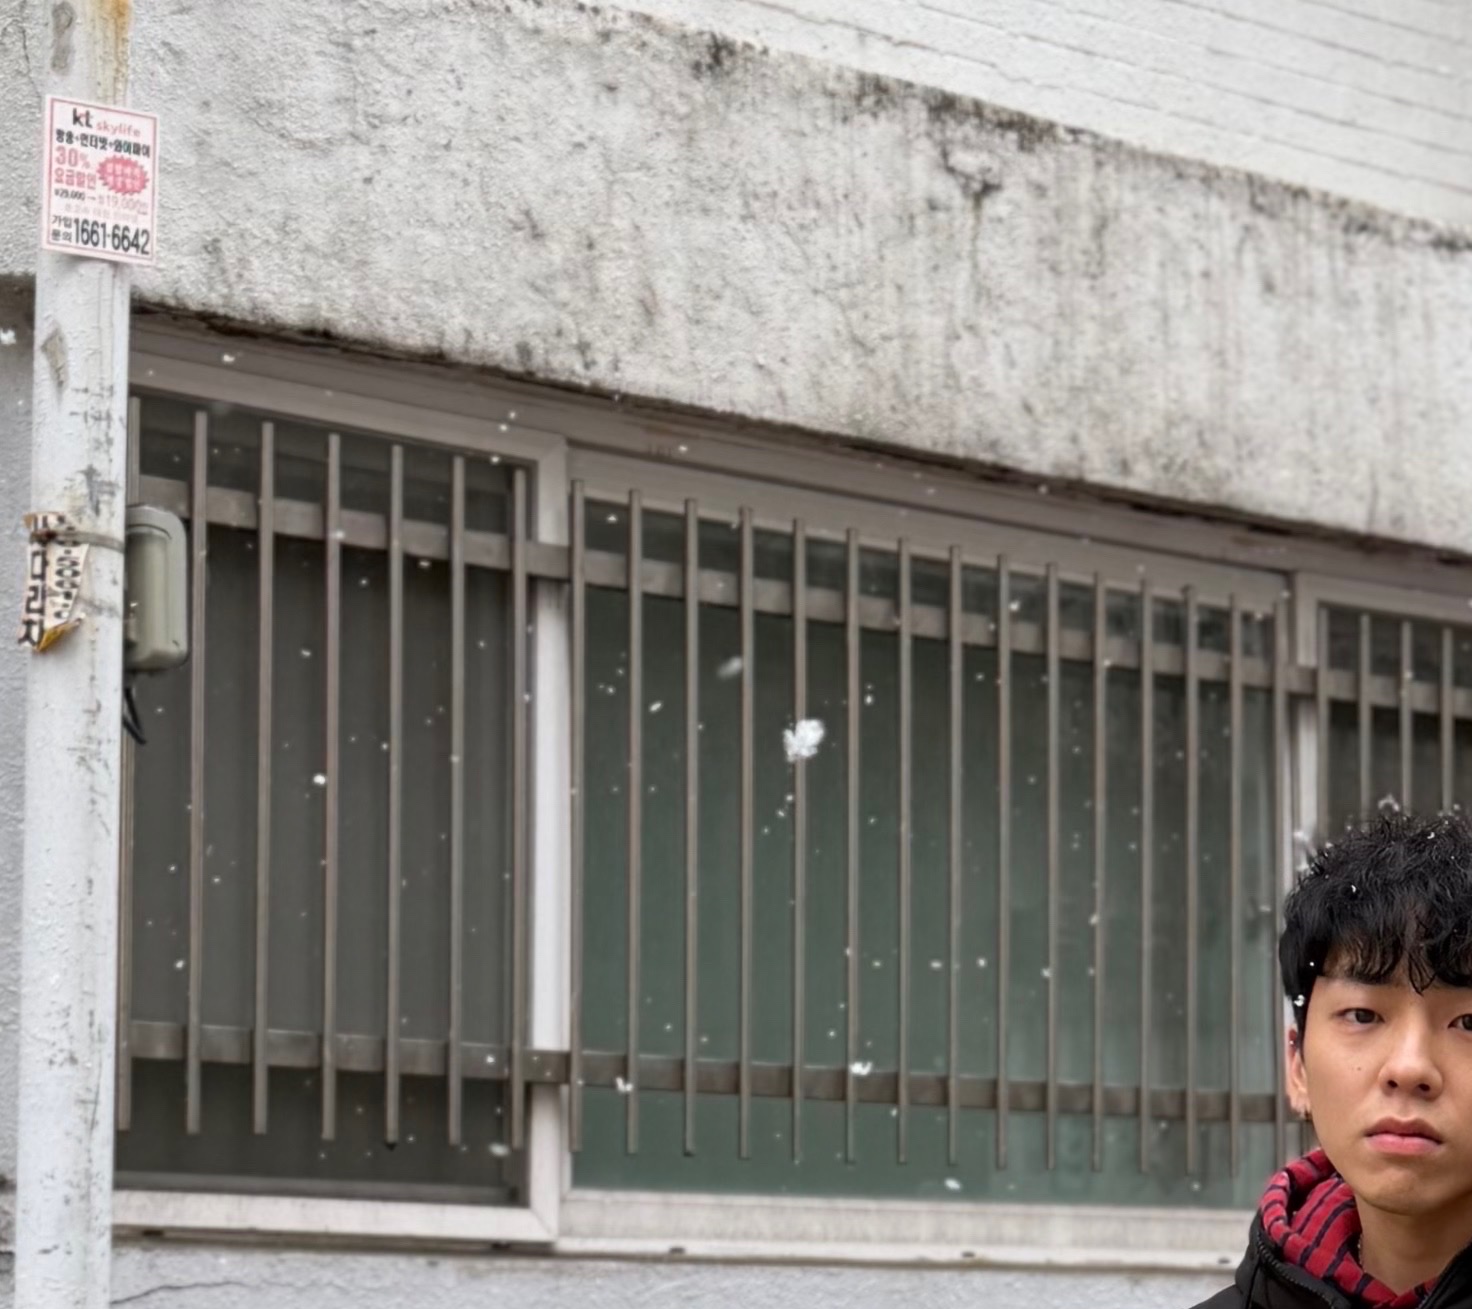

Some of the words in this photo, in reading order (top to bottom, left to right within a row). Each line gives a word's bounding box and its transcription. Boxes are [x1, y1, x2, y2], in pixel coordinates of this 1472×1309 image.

[72, 107, 93, 129] kt
[96, 120, 141, 137] skylife
[55, 145, 91, 169] 30%
[54, 167, 97, 190] 요금할인
[52, 215, 73, 229] 가입
[73, 217, 151, 256] 1661-6642
